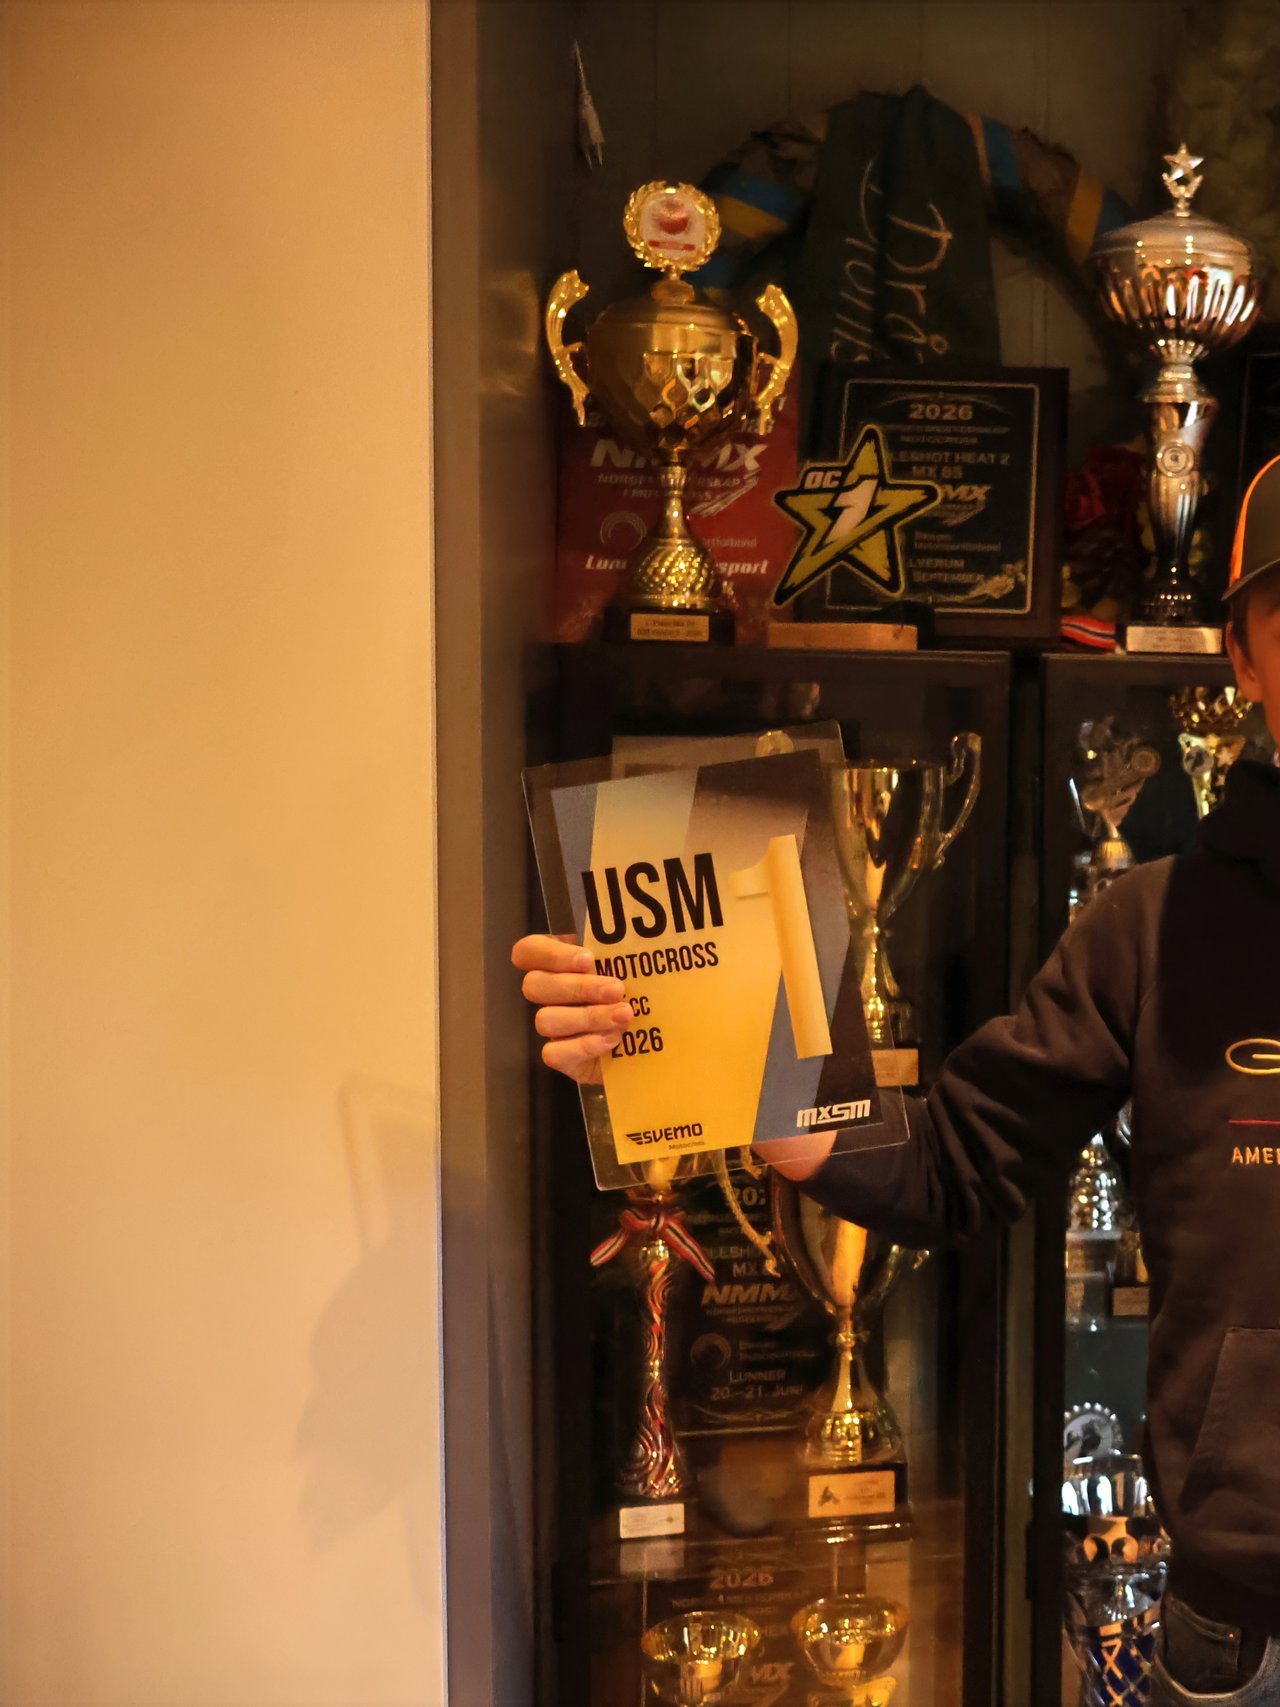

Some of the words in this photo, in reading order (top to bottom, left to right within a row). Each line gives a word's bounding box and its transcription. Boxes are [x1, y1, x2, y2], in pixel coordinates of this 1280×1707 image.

[909, 403, 973, 421] 2026
[954, 452, 996, 464] HEAT
[1000, 453, 1010, 465] 2
[582, 852, 724, 945] USM
[595, 941, 719, 981] MOTOCROSS
